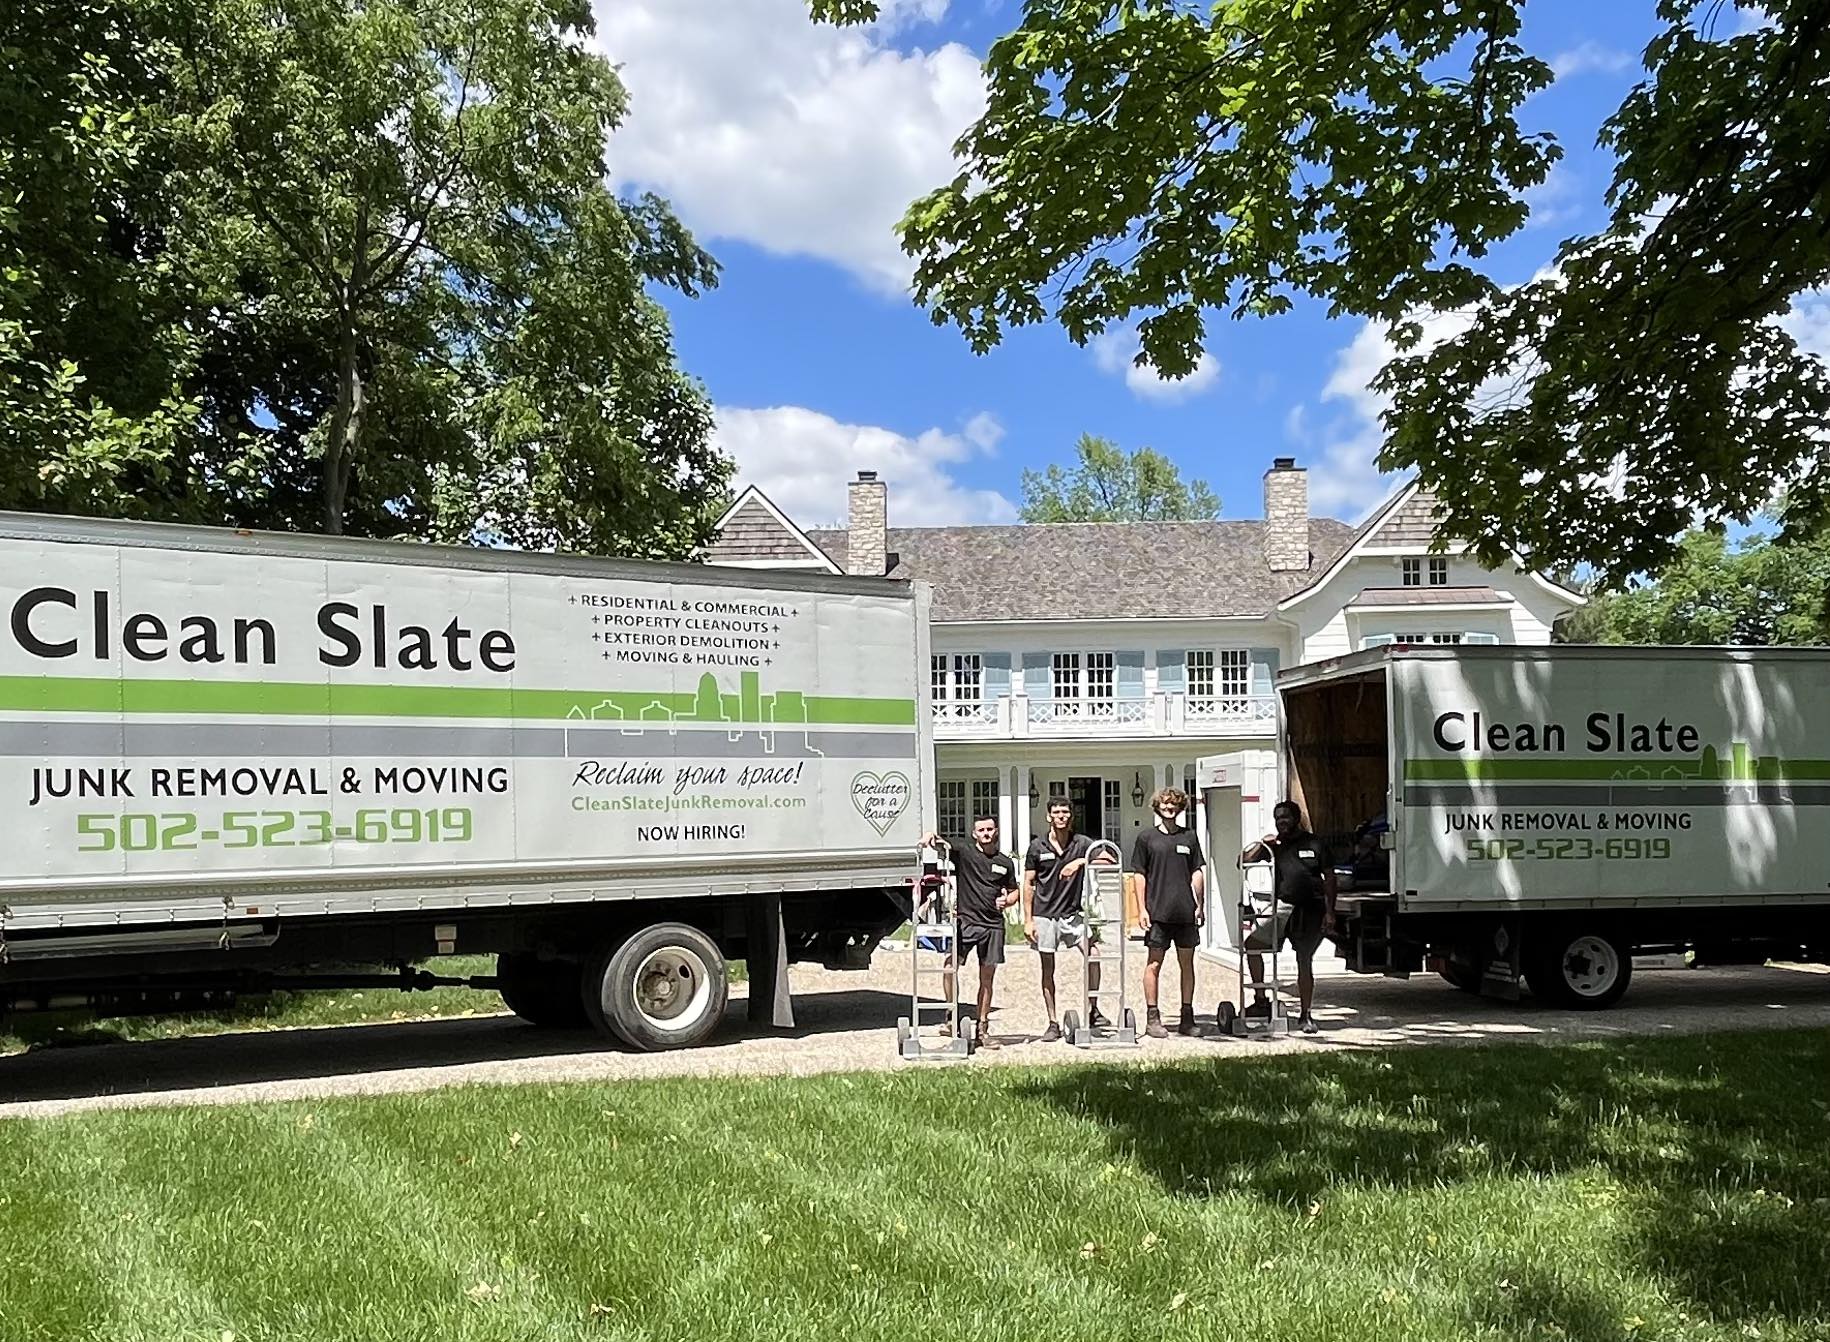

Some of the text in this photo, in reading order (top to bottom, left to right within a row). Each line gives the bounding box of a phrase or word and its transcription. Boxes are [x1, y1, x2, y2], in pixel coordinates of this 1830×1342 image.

[581, 595, 789, 618] RESIDENTIAL & COMMERCIAL
[10, 587, 516, 673] Clean Slate
[604, 614, 769, 633] PROPERTY CLEANOUTS
[604, 632, 770, 650] EXTERIOR DEMOLITION
[616, 650, 760, 667] MOVING & HAULING
[1433, 712, 1700, 754] Clean Slate
[29, 767, 509, 806] JUNK REMOVAL & MOVING
[572, 761, 804, 795] Reclaim your space!
[853, 783, 908, 794] Declutter
[571, 795, 807, 813] CleanSlateJunkRemoval.com
[863, 808, 900, 819] Cause
[865, 797, 897, 810] for a
[77, 808, 473, 852] 502-523-6919
[637, 825, 746, 841] NOW HIRING!
[1445, 813, 1692, 834] JUNK REMOVAL & MOVING
[1467, 838, 1671, 861] 502-523-6919
